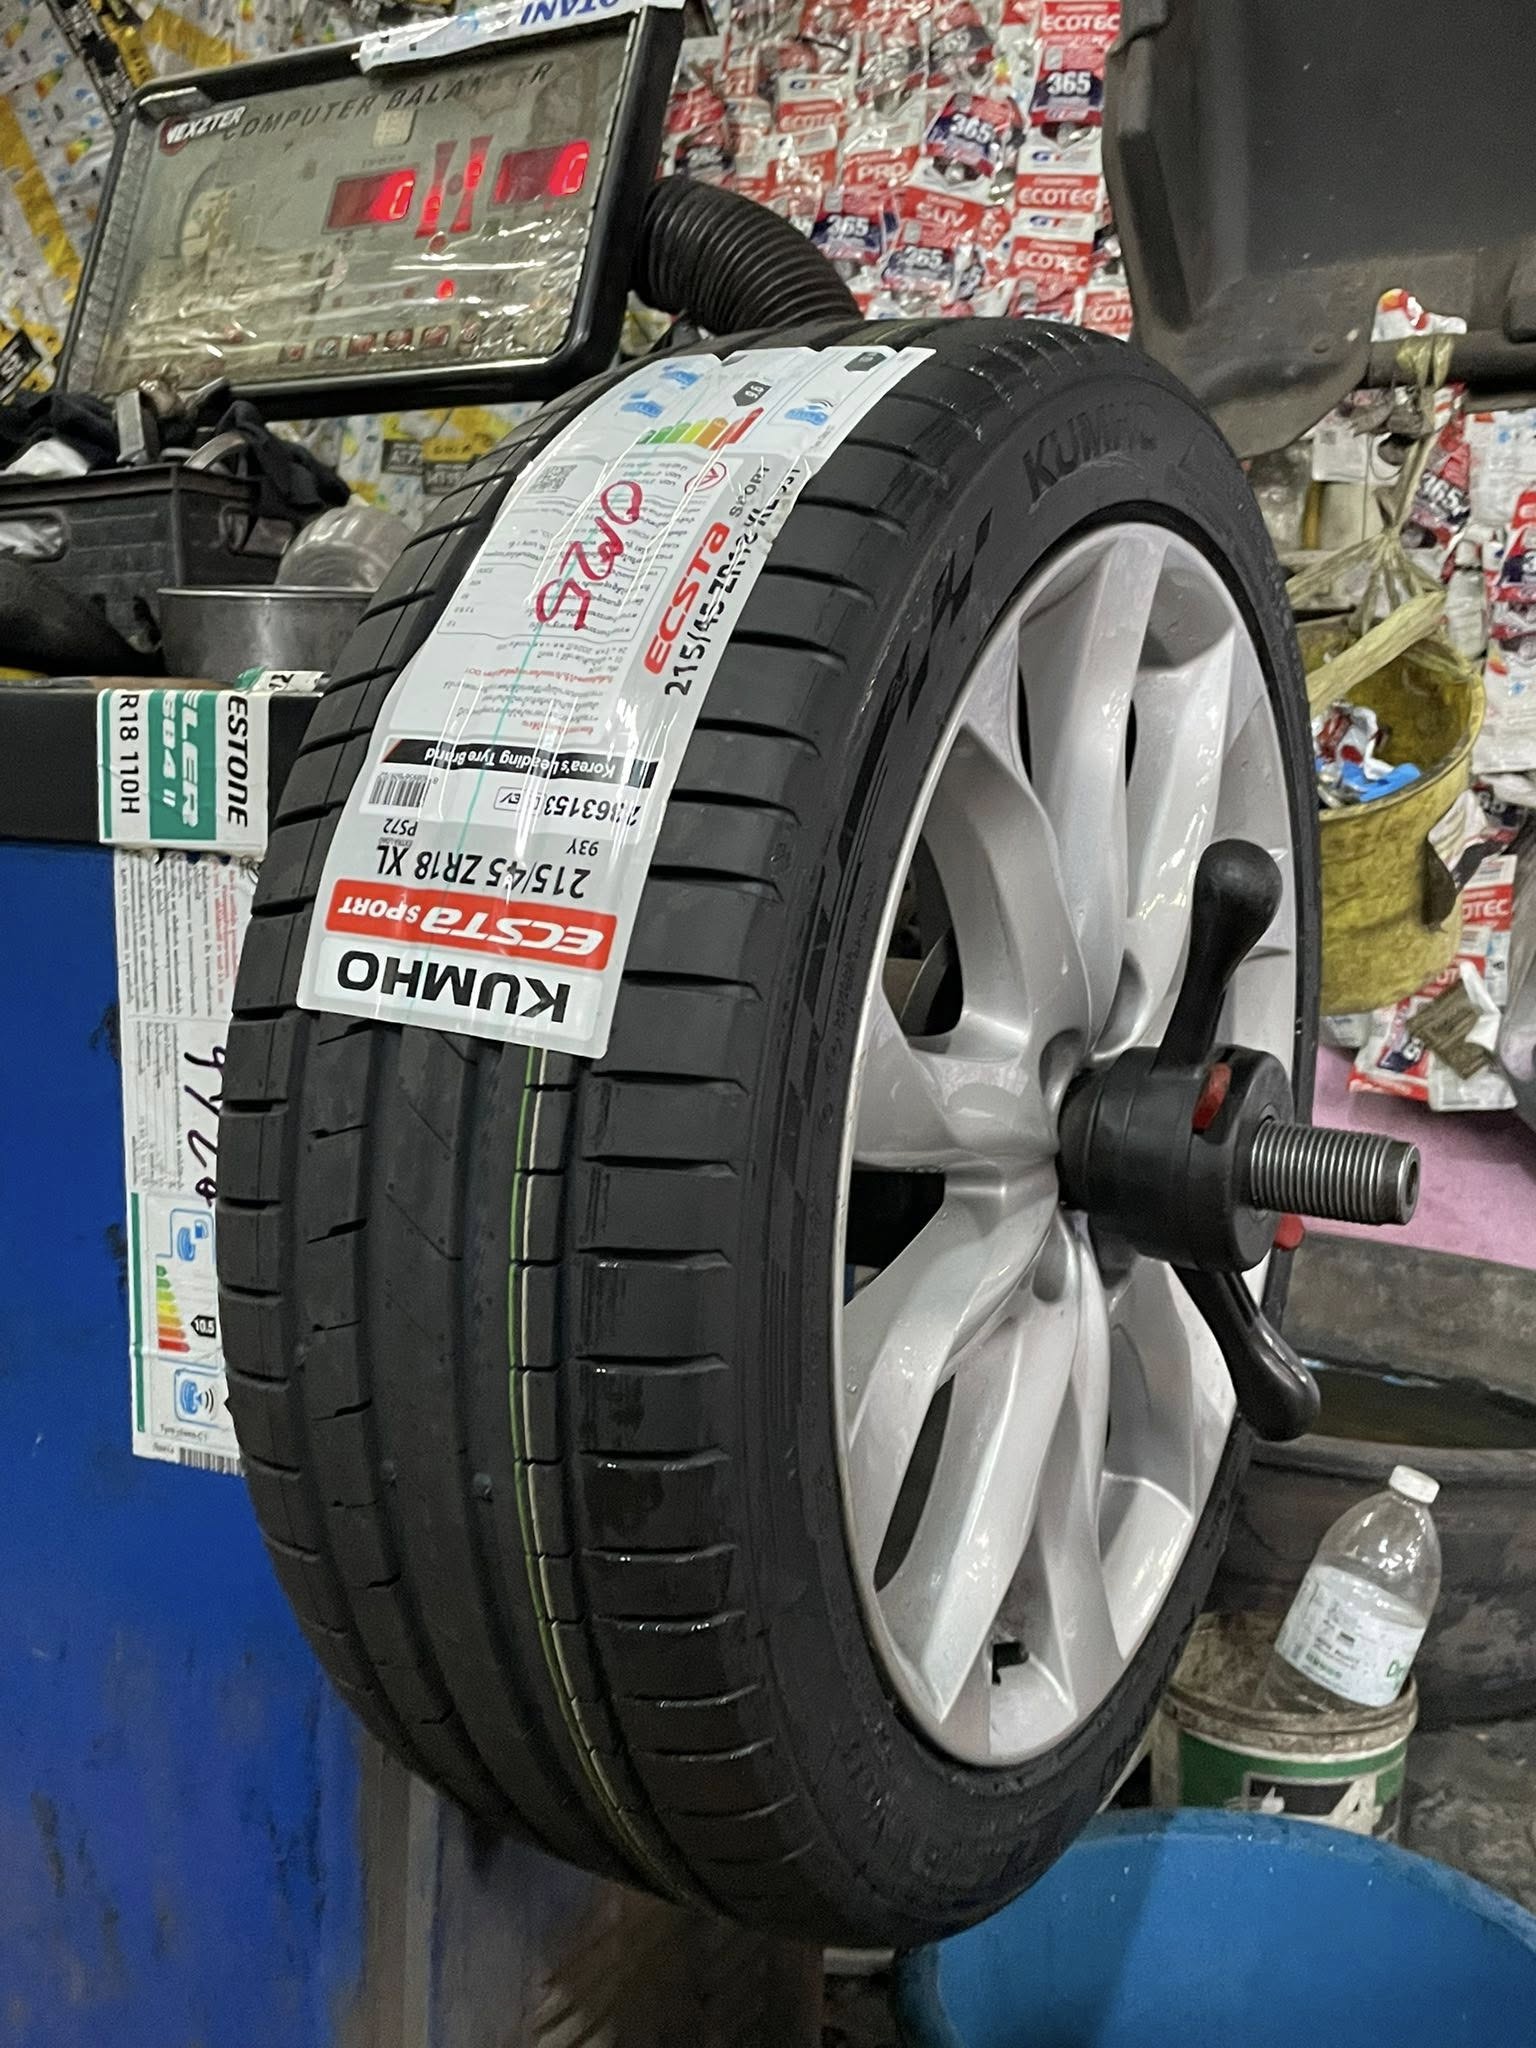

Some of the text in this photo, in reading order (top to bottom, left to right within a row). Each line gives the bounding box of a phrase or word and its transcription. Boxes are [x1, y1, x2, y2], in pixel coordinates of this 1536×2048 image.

[1047, 71, 1090, 96] 365
[950, 112, 992, 145] 365
[1017, 186, 1096, 206] ECOTEC
[826, 215, 870, 237] 365
[119, 694, 140, 815] R18 110H
[467, 750, 497, 767] Tyre
[559, 758, 617, 779] Korea's
[382, 816, 418, 837] PS72
[566, 836, 600, 858] 93Y
[375, 844, 591, 900] 215/45 ZR18 XL
[337, 895, 422, 924] SPORT
[336, 949, 572, 1024] KUMHO
